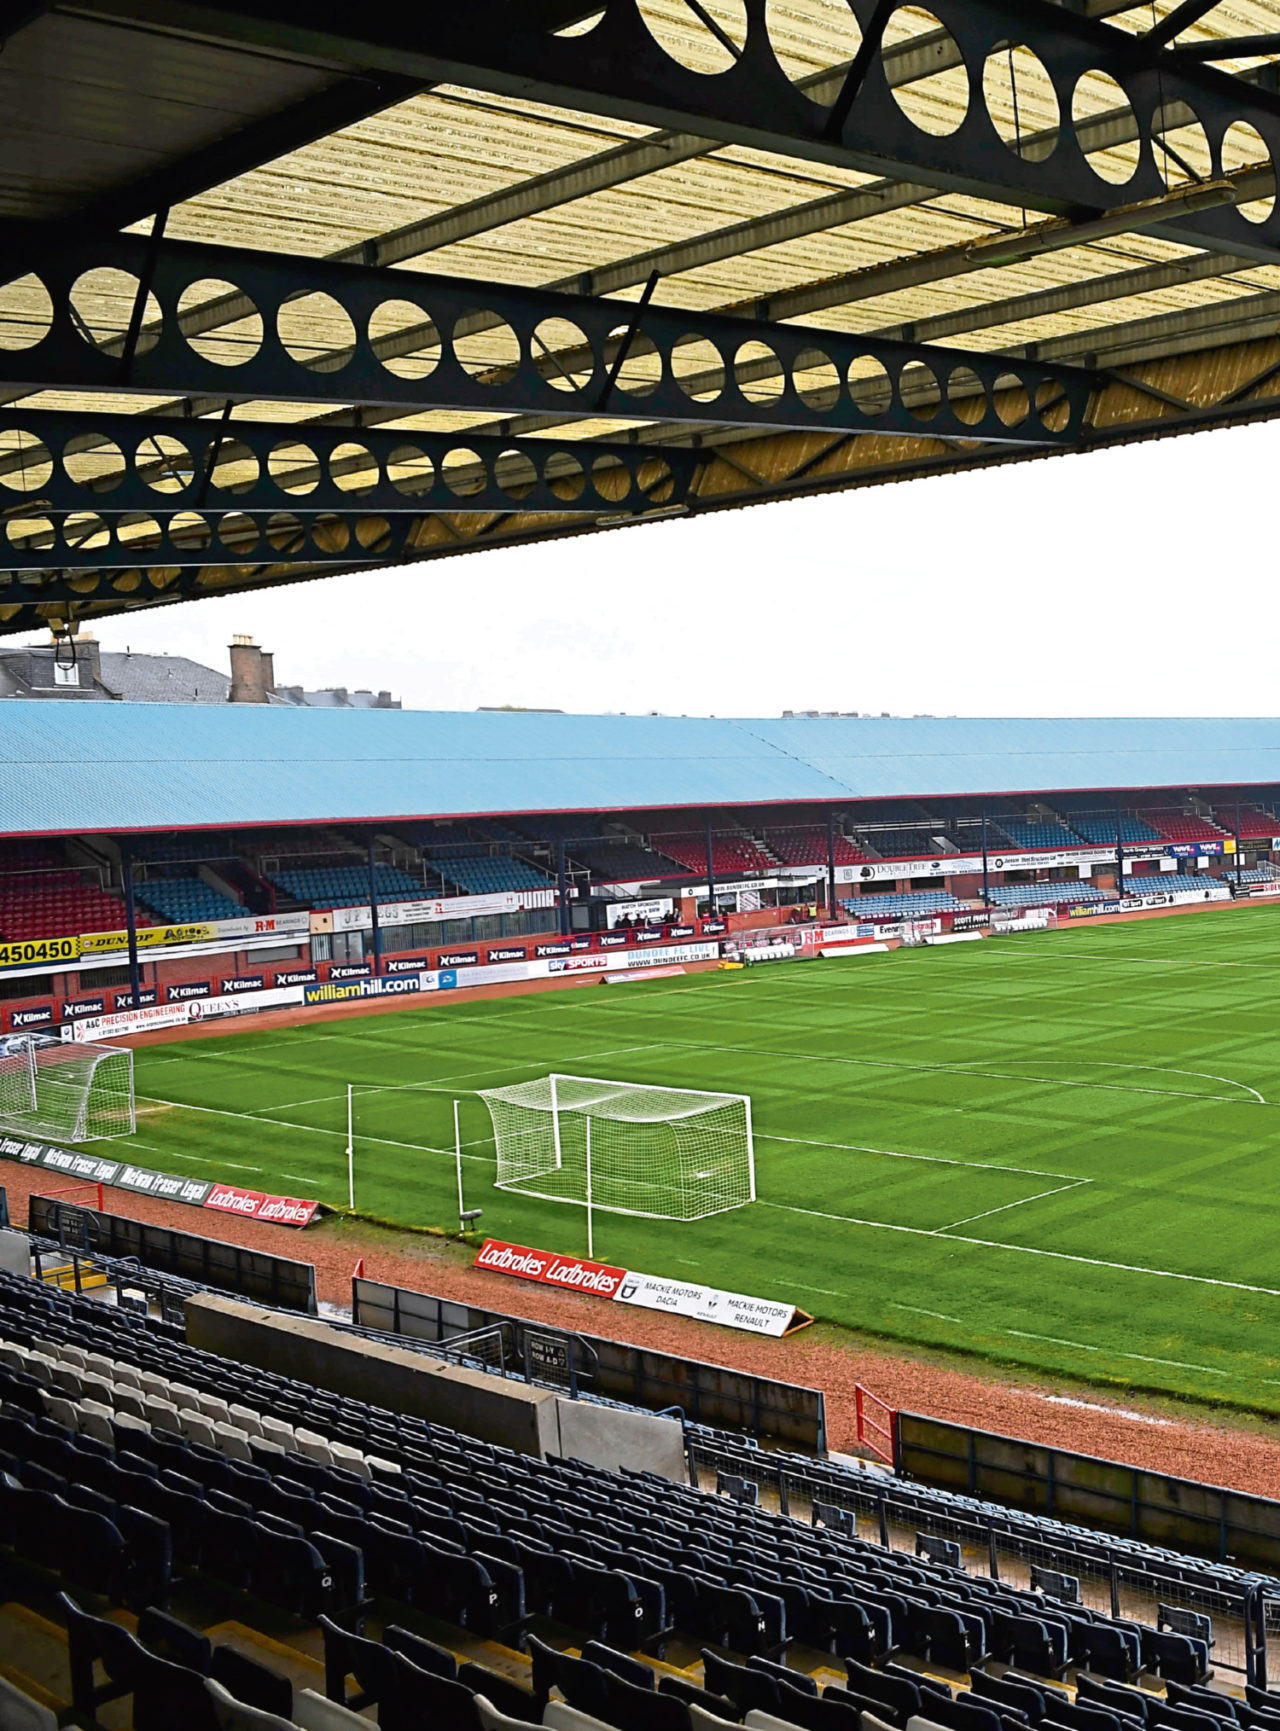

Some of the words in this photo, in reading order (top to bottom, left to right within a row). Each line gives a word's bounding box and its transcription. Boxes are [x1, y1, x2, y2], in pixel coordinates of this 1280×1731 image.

[1069, 903, 1120, 917] williamhill.com
[95, 933, 154, 947] DUNOP
[0, 941, 72, 963] 450450
[499, 950, 524, 959] Kilmac
[546, 946, 570, 954] Kilmac
[627, 948, 670, 960] DUNDEE
[674, 946, 687, 956] FC
[689, 943, 710, 953] LIVE
[398, 960, 425, 969] Kilmac
[450, 956, 476, 964] Kilmac
[550, 961, 566, 971] sky
[568, 956, 607, 969] SPORTS
[287, 973, 316, 982] Kilmac
[341, 967, 370, 976] Kilmac
[234, 979, 262, 988] Kilmac
[306, 978, 419, 1002] williamhill.com
[180, 987, 208, 996] Kilmac
[127, 994, 154, 1005] Kmac
[74, 1003, 102, 1014] Kilmac
[101, 1010, 138, 1026] PRECISION
[139, 1004, 186, 1020] ENGINEERING
[23, 1011, 51, 1022] Kilmac
[20, 1142, 43, 1161] Legal
[69, 1155, 97, 1174] Fraser
[94, 1161, 119, 1180] Legal
[150, 1173, 183, 1195] Fraser
[180, 1180, 209, 1201] Legal
[207, 1189, 259, 1212] Ladbrokes
[258, 1196, 313, 1221] Ladbrokes
[478, 1244, 547, 1276] Ladbrokes
[546, 1258, 620, 1293] Ladbrokes
[645, 1282, 672, 1295] MACKIE
[672, 1287, 703, 1301] MOTORS
[656, 1296, 678, 1307] DACIA
[727, 1298, 754, 1312] MACKIE
[754, 1304, 789, 1319] MOTORS
[734, 1313, 770, 1329] RENAULT
[322, 1577, 332, 1588] Q
[490, 1593, 498, 1604] P
